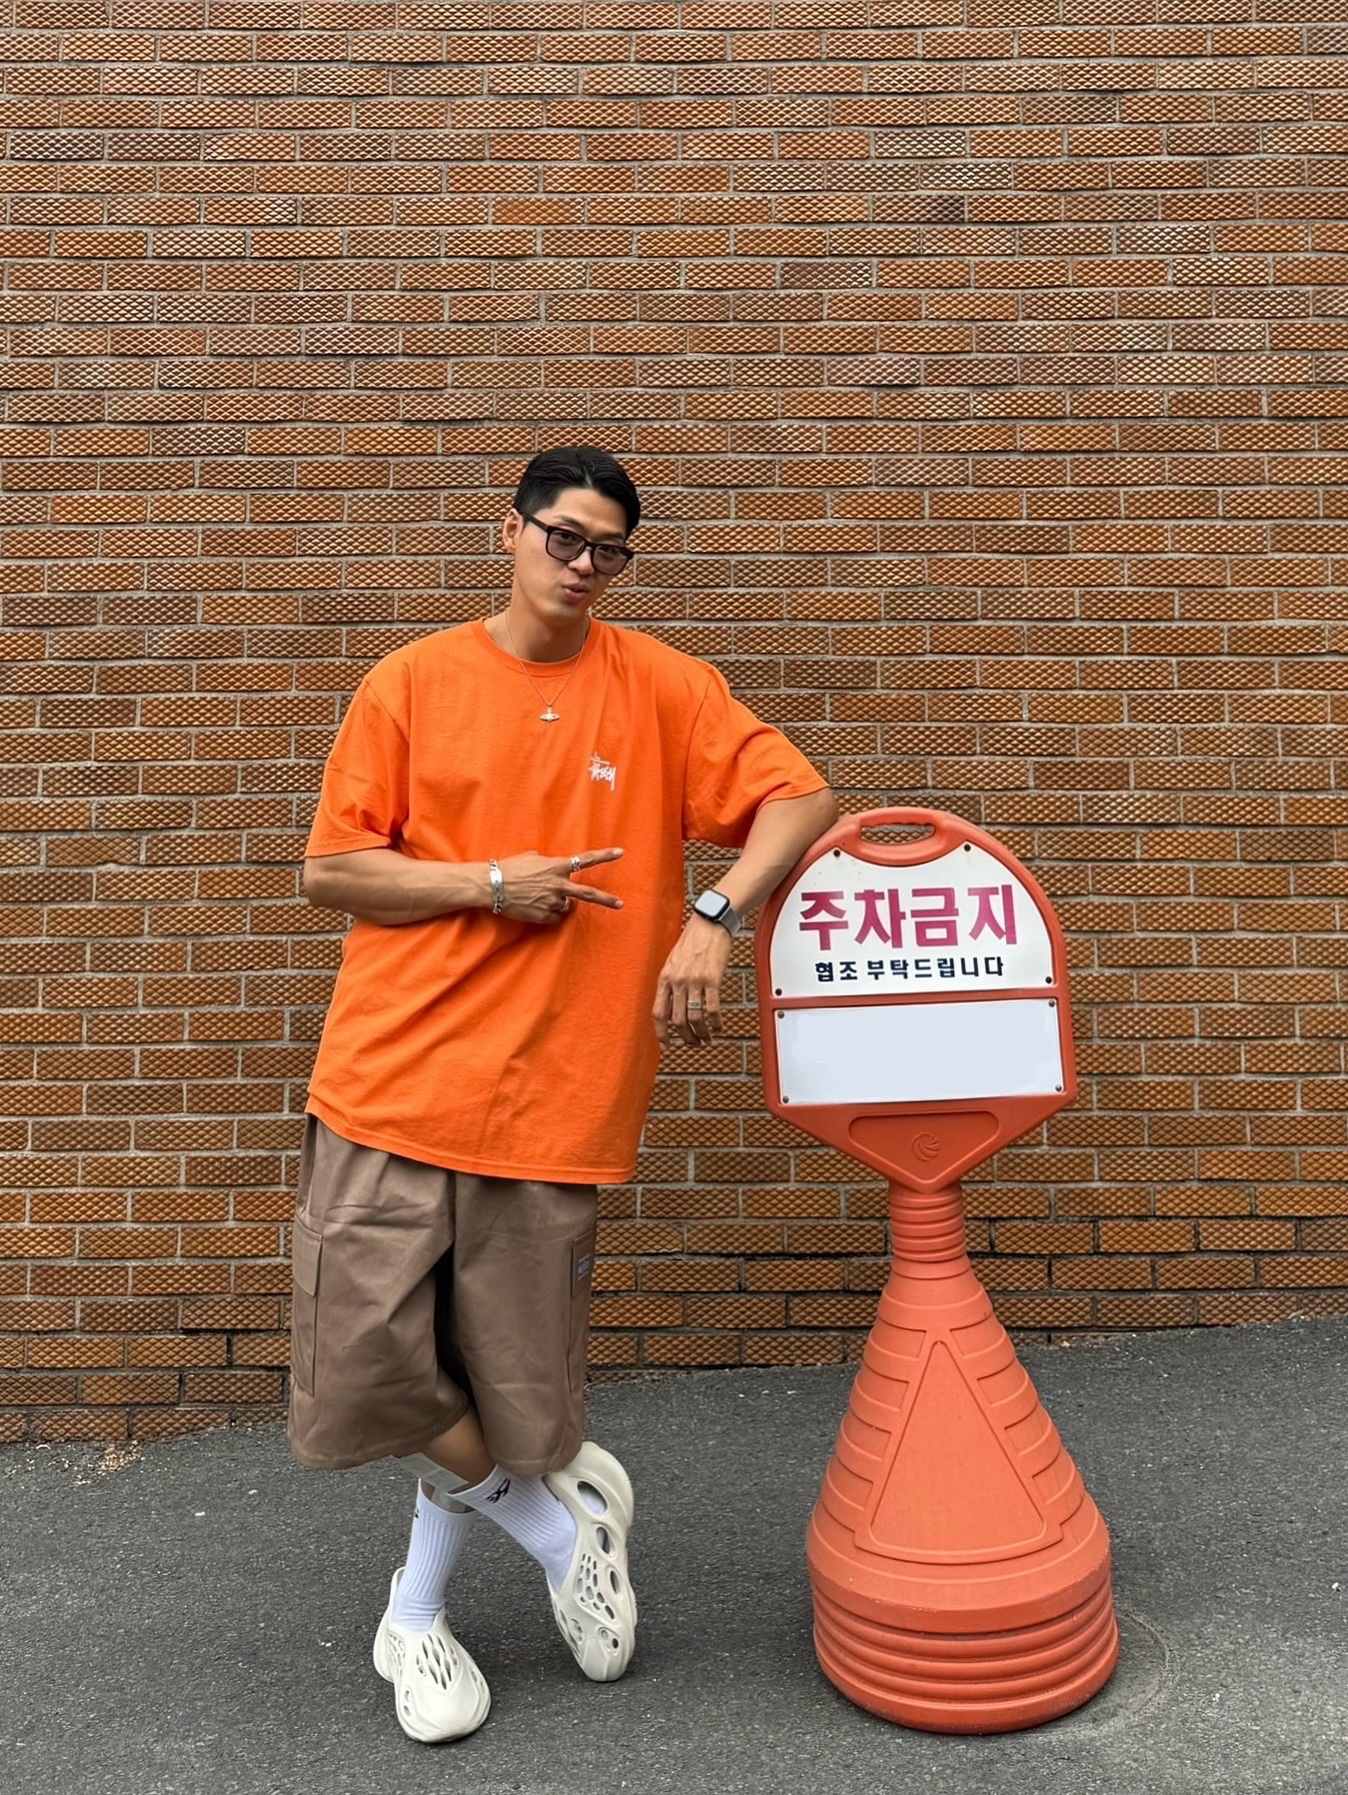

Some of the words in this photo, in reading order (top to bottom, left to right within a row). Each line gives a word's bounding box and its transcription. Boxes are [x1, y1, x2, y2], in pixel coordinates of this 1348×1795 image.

[799, 884, 1018, 951] 주차금지
[815, 960, 858, 982] 협조
[867, 956, 1004, 981] 부탁드립니다
